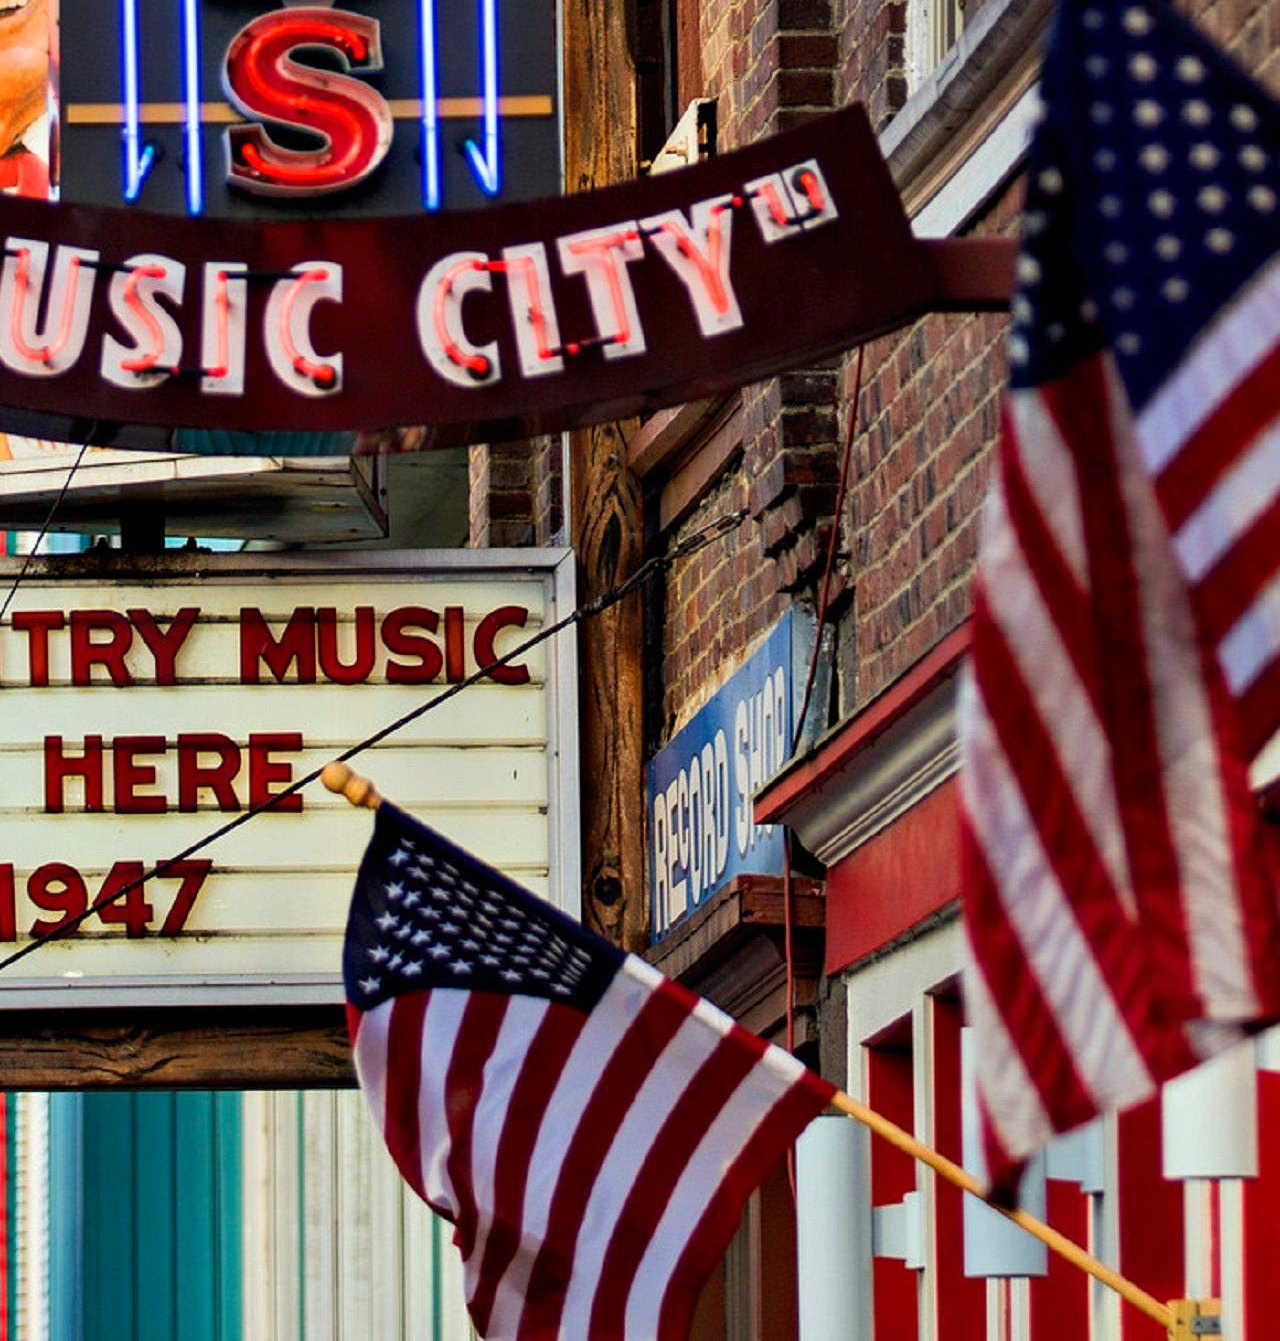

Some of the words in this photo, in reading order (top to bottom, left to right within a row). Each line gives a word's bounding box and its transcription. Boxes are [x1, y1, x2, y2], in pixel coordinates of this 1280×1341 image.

[240, 605, 530, 687] MUSIC
[45, 732, 305, 815] HERE
[654, 729, 729, 934] RECORD
